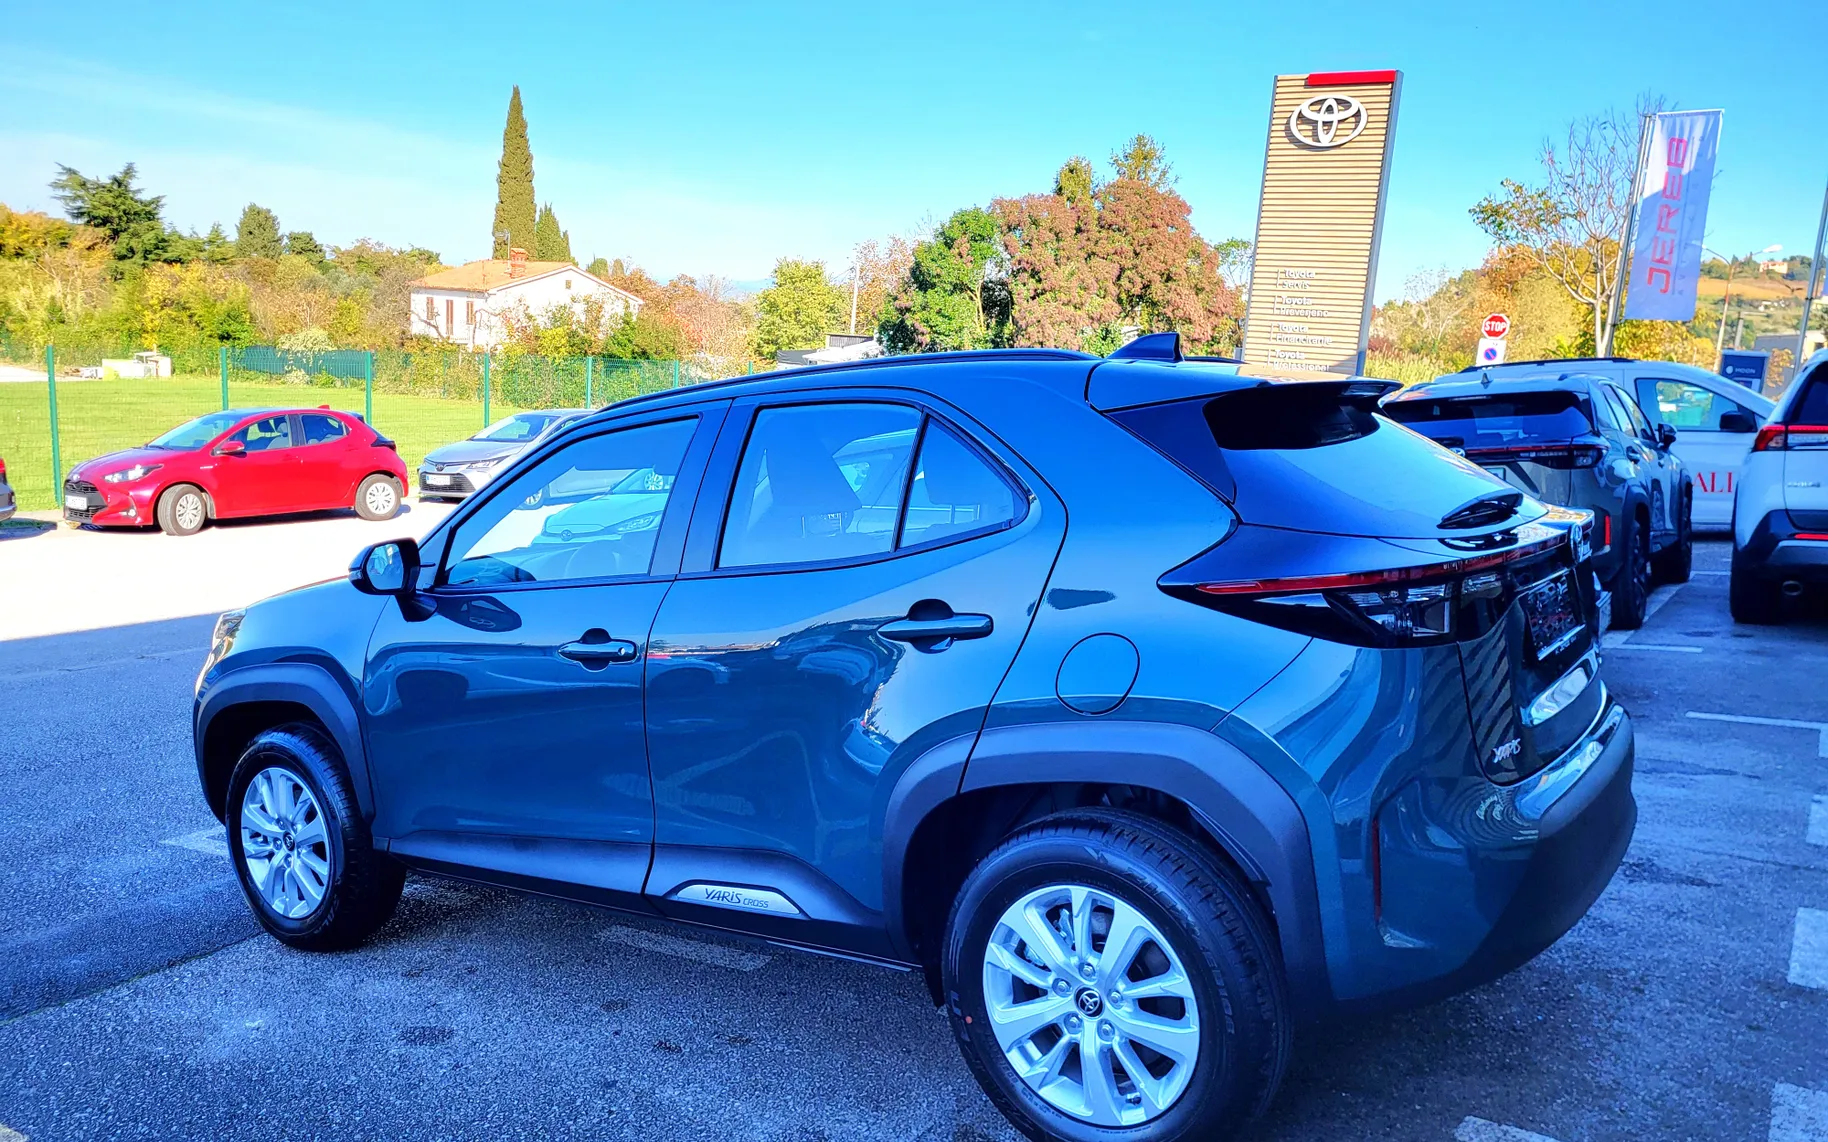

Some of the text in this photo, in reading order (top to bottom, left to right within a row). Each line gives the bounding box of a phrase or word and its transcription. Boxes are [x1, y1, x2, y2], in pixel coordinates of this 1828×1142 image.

[1647, 137, 1688, 294] JEREB
[1283, 269, 1315, 279] Toyota
[1280, 296, 1312, 306] Toyota
[1278, 323, 1309, 333] Toyota
[1484, 320, 1507, 332] STOP
[1274, 350, 1305, 360] Toyota
[743, 898, 769, 909] CROSS
